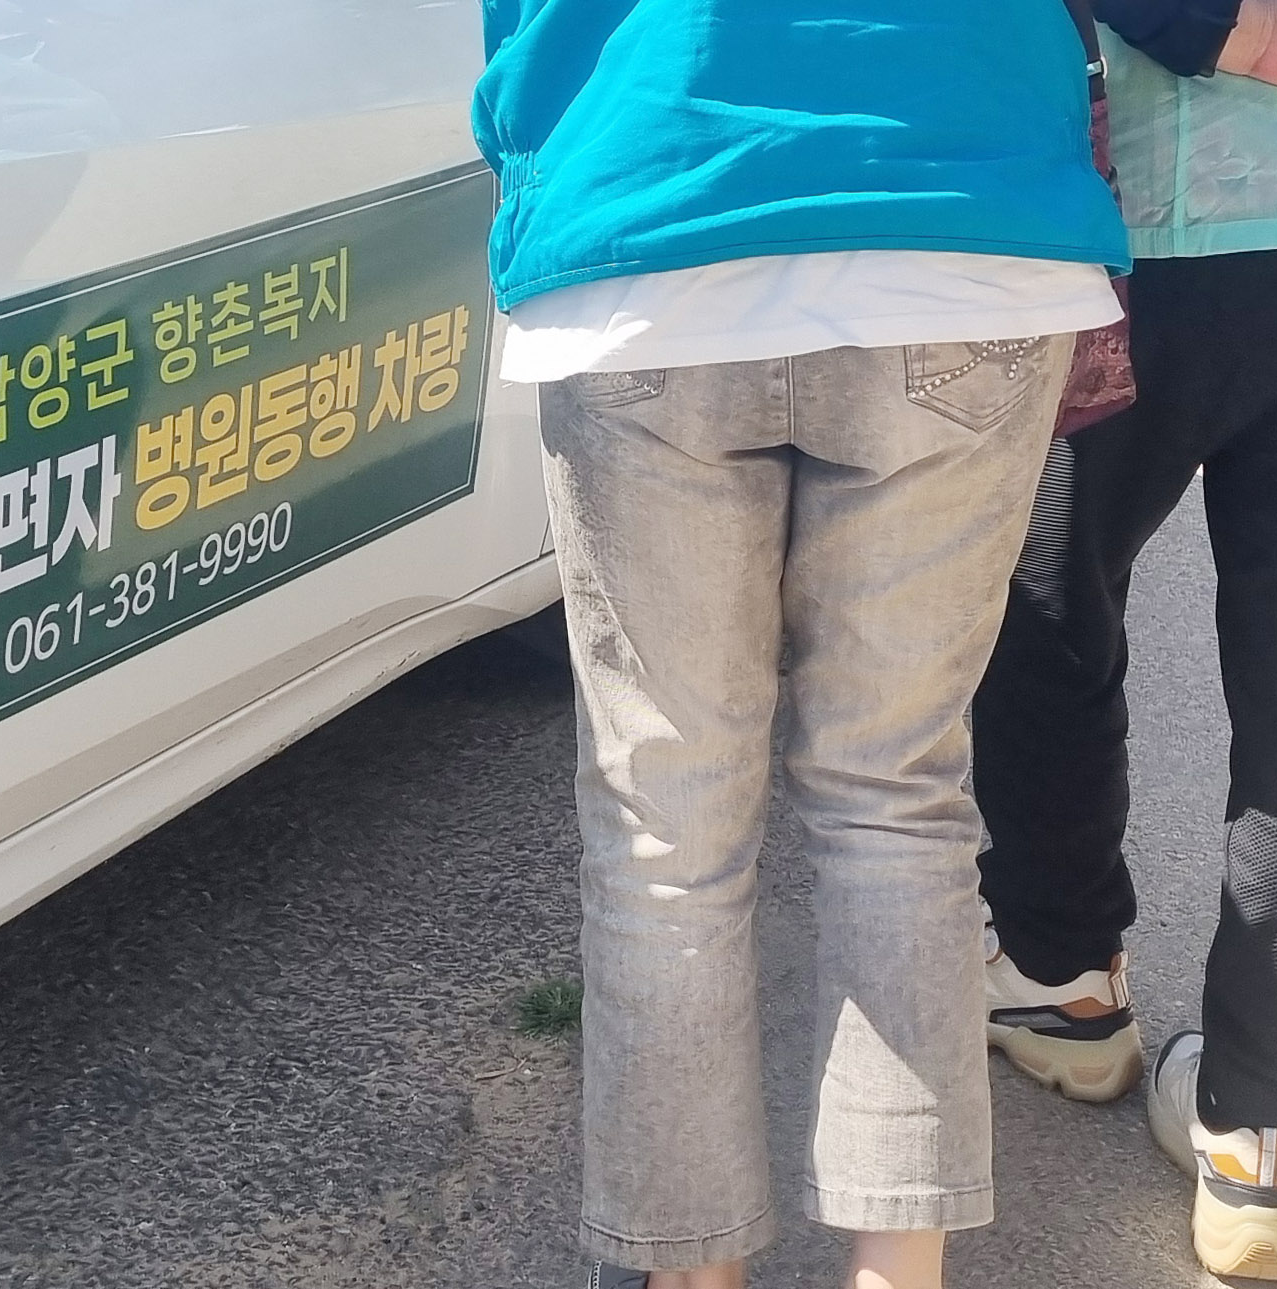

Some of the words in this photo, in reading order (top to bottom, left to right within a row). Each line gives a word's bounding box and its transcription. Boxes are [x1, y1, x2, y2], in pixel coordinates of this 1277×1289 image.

[151, 246, 351, 386] 향촌복지
[134, 346, 362, 531] 병원동행
[369, 305, 470, 432] 차량
[4, 500, 293, 673] 061-381-9990
